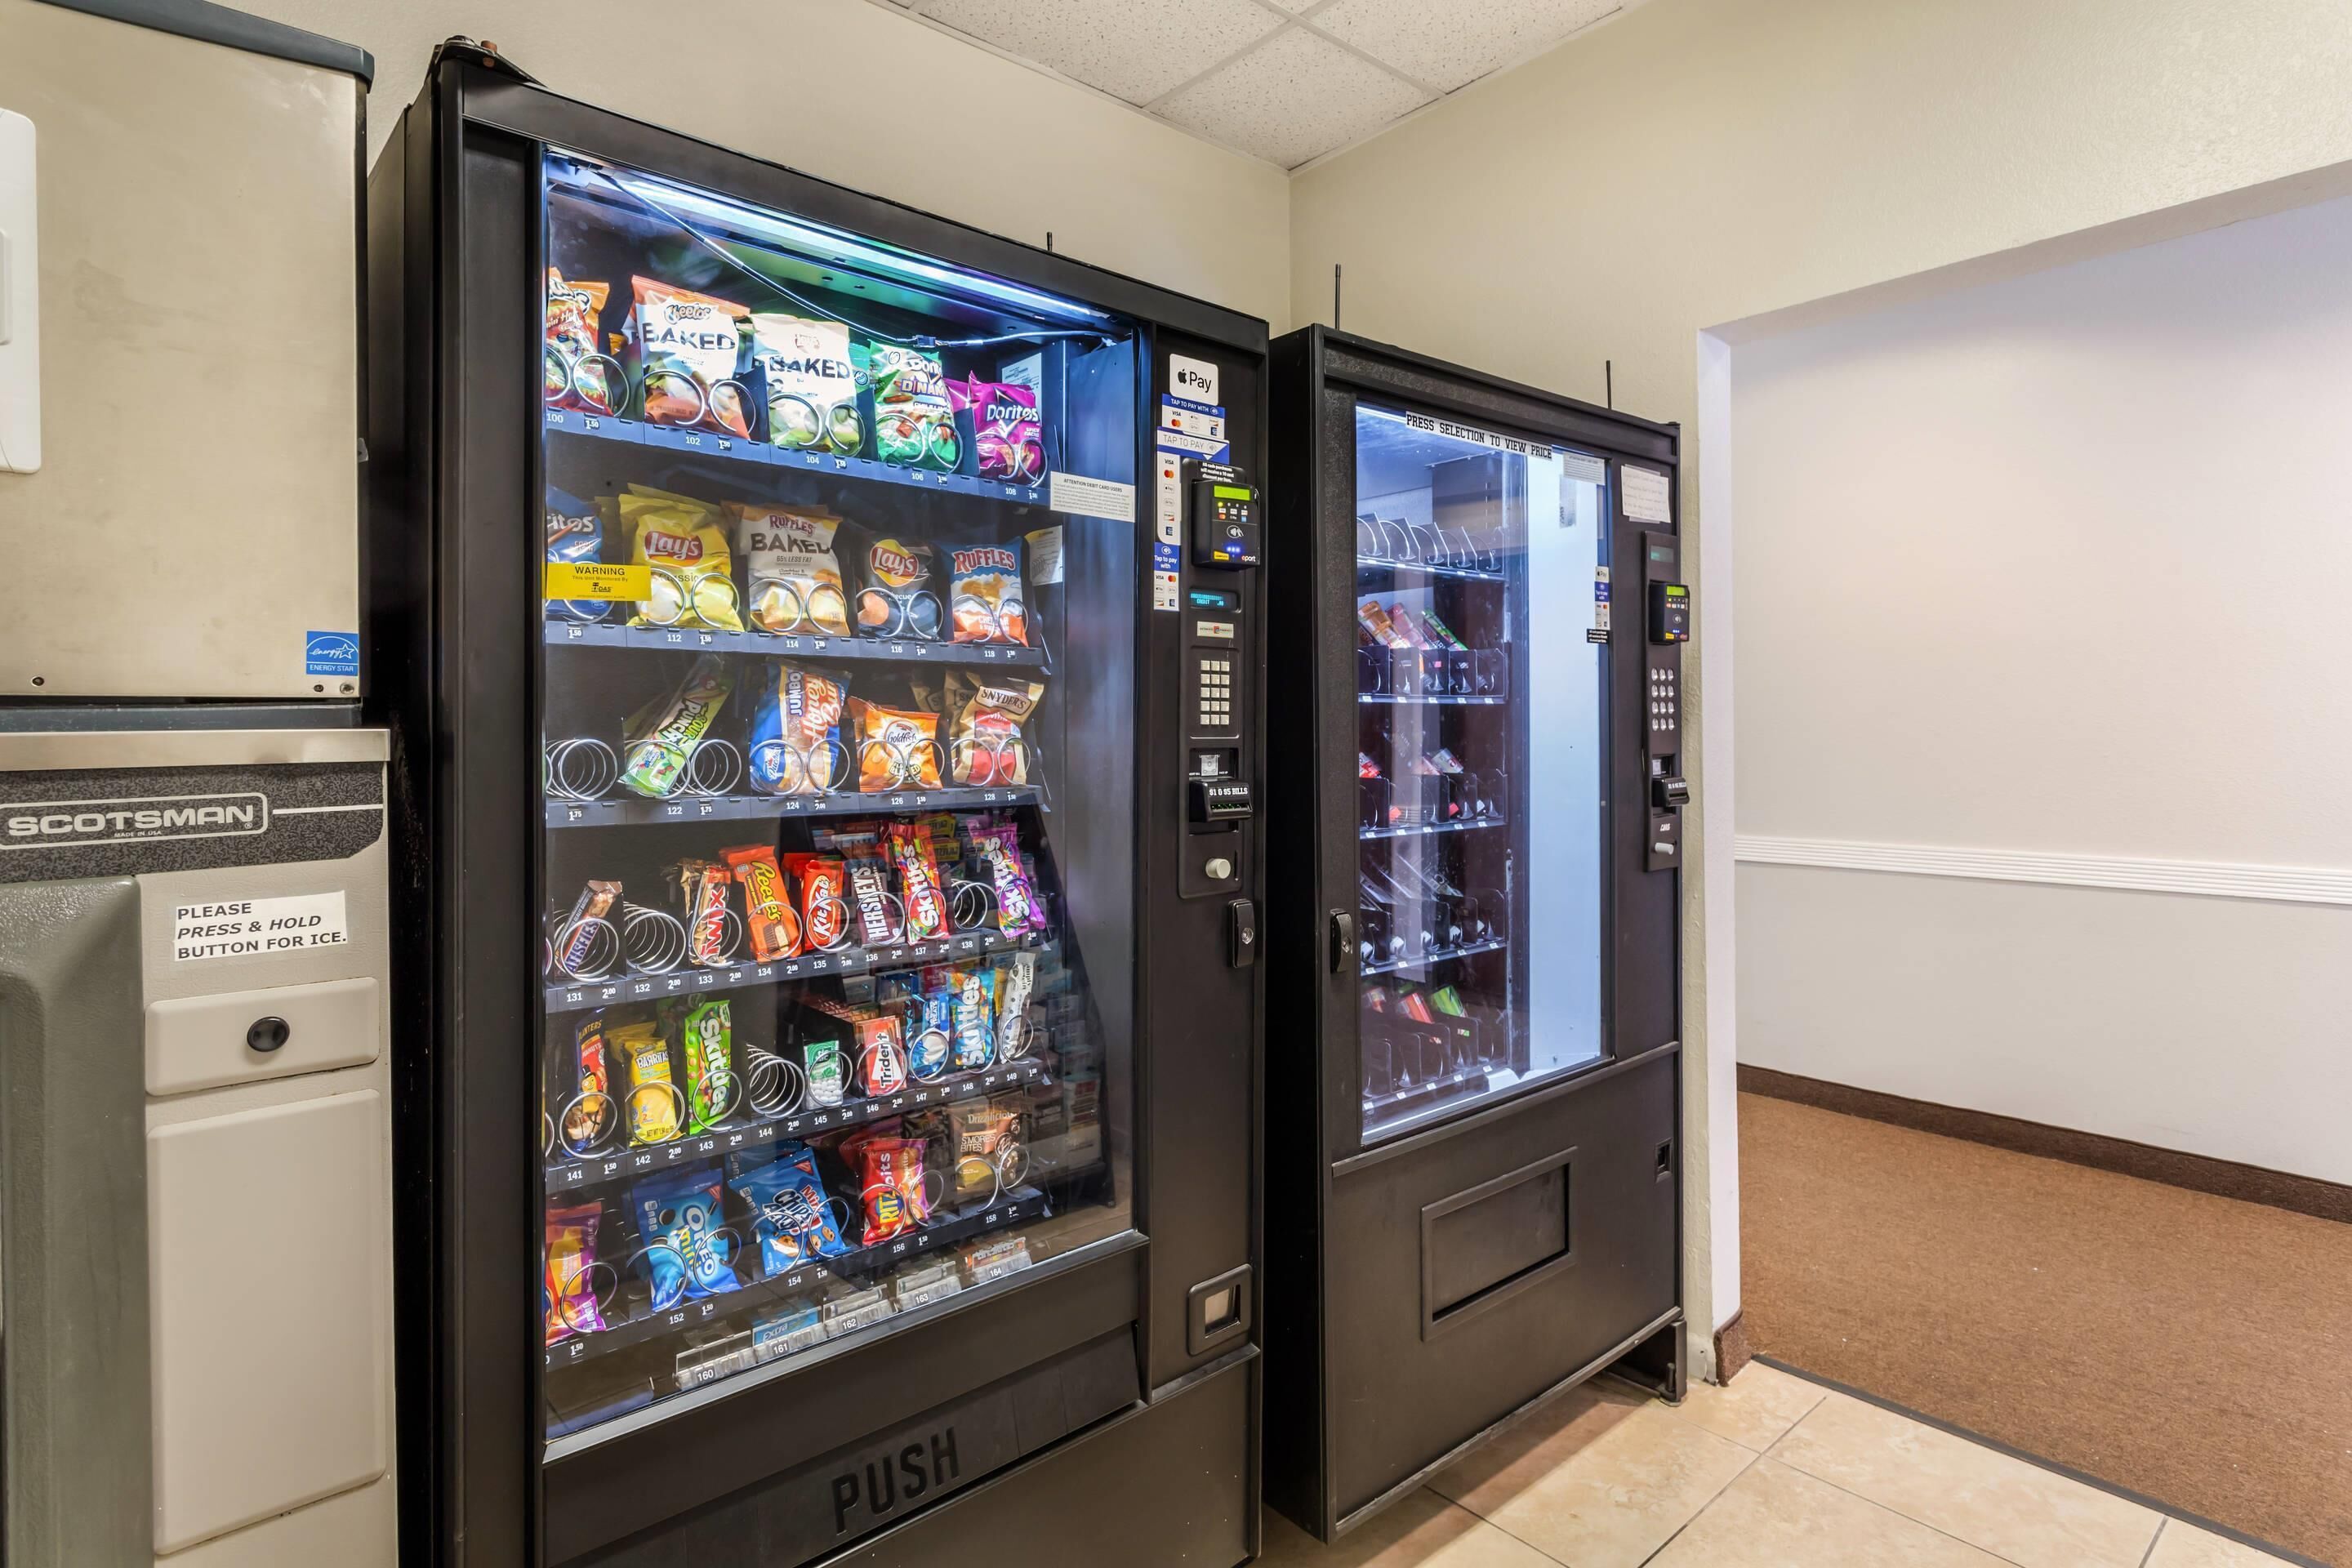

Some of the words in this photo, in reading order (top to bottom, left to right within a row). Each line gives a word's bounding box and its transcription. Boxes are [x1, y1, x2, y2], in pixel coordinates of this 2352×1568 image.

[664, 304, 710, 324] Cheetos
[643, 323, 735, 350] BAKED
[769, 355, 850, 379] BAKED
[1190, 371, 1211, 393] Pay
[987, 404, 1039, 421] Doritos
[546, 415, 564, 423] 100
[685, 436, 701, 445] 102
[1163, 434, 1177, 443] TAP
[1179, 438, 1189, 446] TO
[1191, 440, 1204, 450] PAY
[1406, 414, 1435, 431] PRESS
[1440, 422, 1485, 443] SELECTION
[1489, 434, 1500, 447] TO
[1504, 439, 1526, 452] VIEW
[1530, 445, 1552, 459] PRICE
[806, 455, 819, 465] 104
[911, 472, 924, 481] 106
[1063, 479, 1086, 487] ATTENTION
[1005, 488, 1017, 496] 108
[547, 513, 595, 532] itos
[769, 514, 814, 536] RUFFLES
[953, 547, 1016, 574] RUFFLES
[575, 566, 626, 576] WARNING
[310, 664, 336, 672] ENERGY
[788, 671, 803, 716] JUMBO
[821, 679, 841, 726] Bun
[803, 676, 827, 743] Honey
[887, 732, 915, 743] Goldfish
[667, 807, 683, 815] 122
[8, 804, 253, 837] SCOTSMAN
[984, 836, 1031, 919] Skittles
[751, 861, 783, 921] Reese's
[903, 844, 939, 927] Skittles
[177, 902, 252, 920] PLEASE
[177, 923, 242, 940] PRESS
[248, 921, 262, 933] &
[270, 915, 321, 931] HOLD
[701, 886, 726, 959] TWIX
[177, 941, 259, 960] BUTTON
[267, 935, 304, 950] FOR
[310, 932, 347, 945] ICE.
[961, 941, 973, 949] 138
[813, 960, 826, 969] 135
[758, 968, 772, 976] 134
[698, 975, 713, 984] 133
[635, 984, 650, 992] 132
[567, 993, 582, 1002] 131
[700, 1018, 728, 1117] Skittles
[1007, 1073, 1018, 1081] 149
[963, 1083, 973, 1091] 148
[916, 1094, 927, 1102] 147
[866, 1104, 879, 1112] 146
[814, 1116, 827, 1125] 145
[759, 1129, 773, 1137] 144
[961, 1134, 996, 1145] S'MORES
[699, 1142, 713, 1150] 143
[960, 1143, 982, 1152] BITES
[635, 1156, 651, 1165] 142
[568, 1171, 582, 1180] 141
[773, 1189, 813, 1223] Chips
[879, 1190, 899, 1224] RITZ
[986, 1214, 997, 1223] 158
[686, 1207, 715, 1276] OREO
[893, 1244, 906, 1253] 156
[990, 1267, 1002, 1277] 164
[788, 1276, 802, 1286] 154
[915, 1294, 929, 1303] 163
[669, 1313, 684, 1324] 152
[842, 1319, 857, 1330] 162
[773, 1343, 788, 1354] 161
[697, 1370, 714, 1381] 160
[831, 1426, 960, 1536] PUSH
